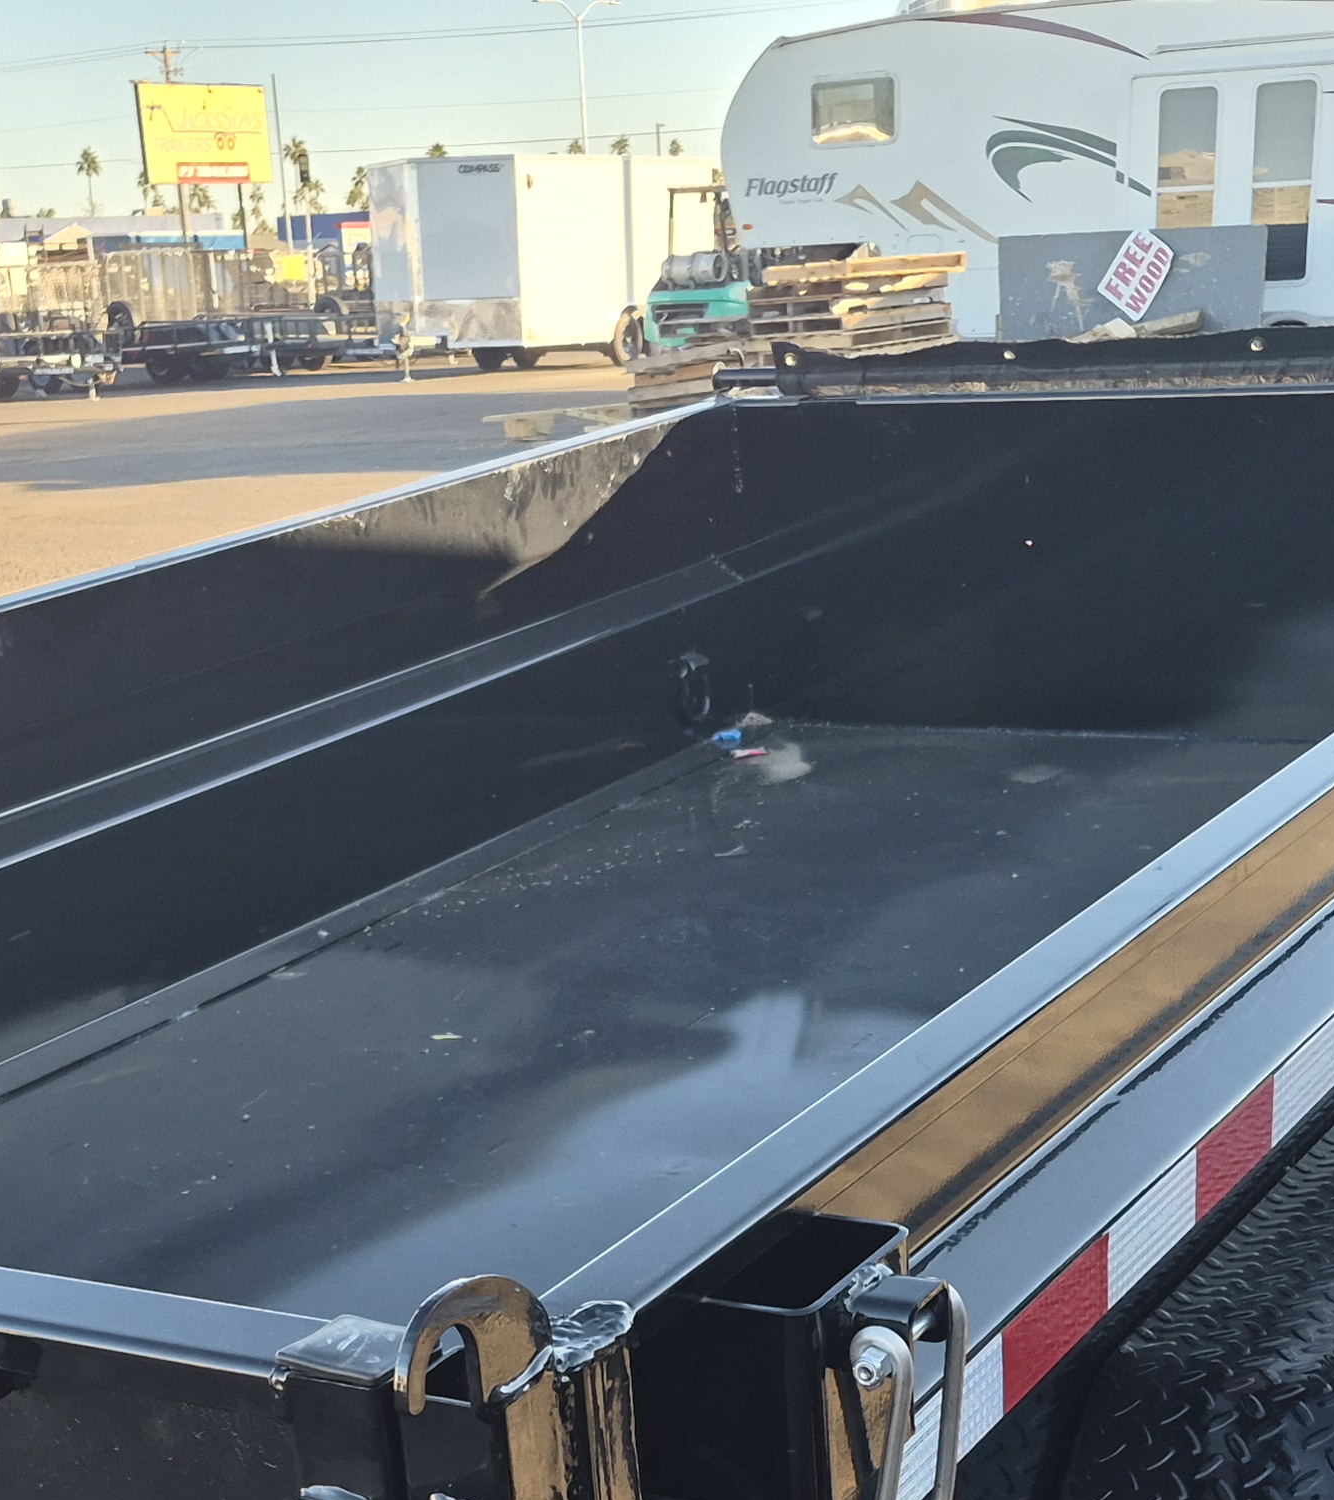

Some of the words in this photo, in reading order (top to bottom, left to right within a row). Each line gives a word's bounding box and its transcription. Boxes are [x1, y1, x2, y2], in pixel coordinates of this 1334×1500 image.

[457, 163, 502, 174] COMPASS
[745, 172, 838, 198] Flagstaff
[1104, 231, 1154, 301] FREE
[1124, 246, 1170, 314] WOOD
